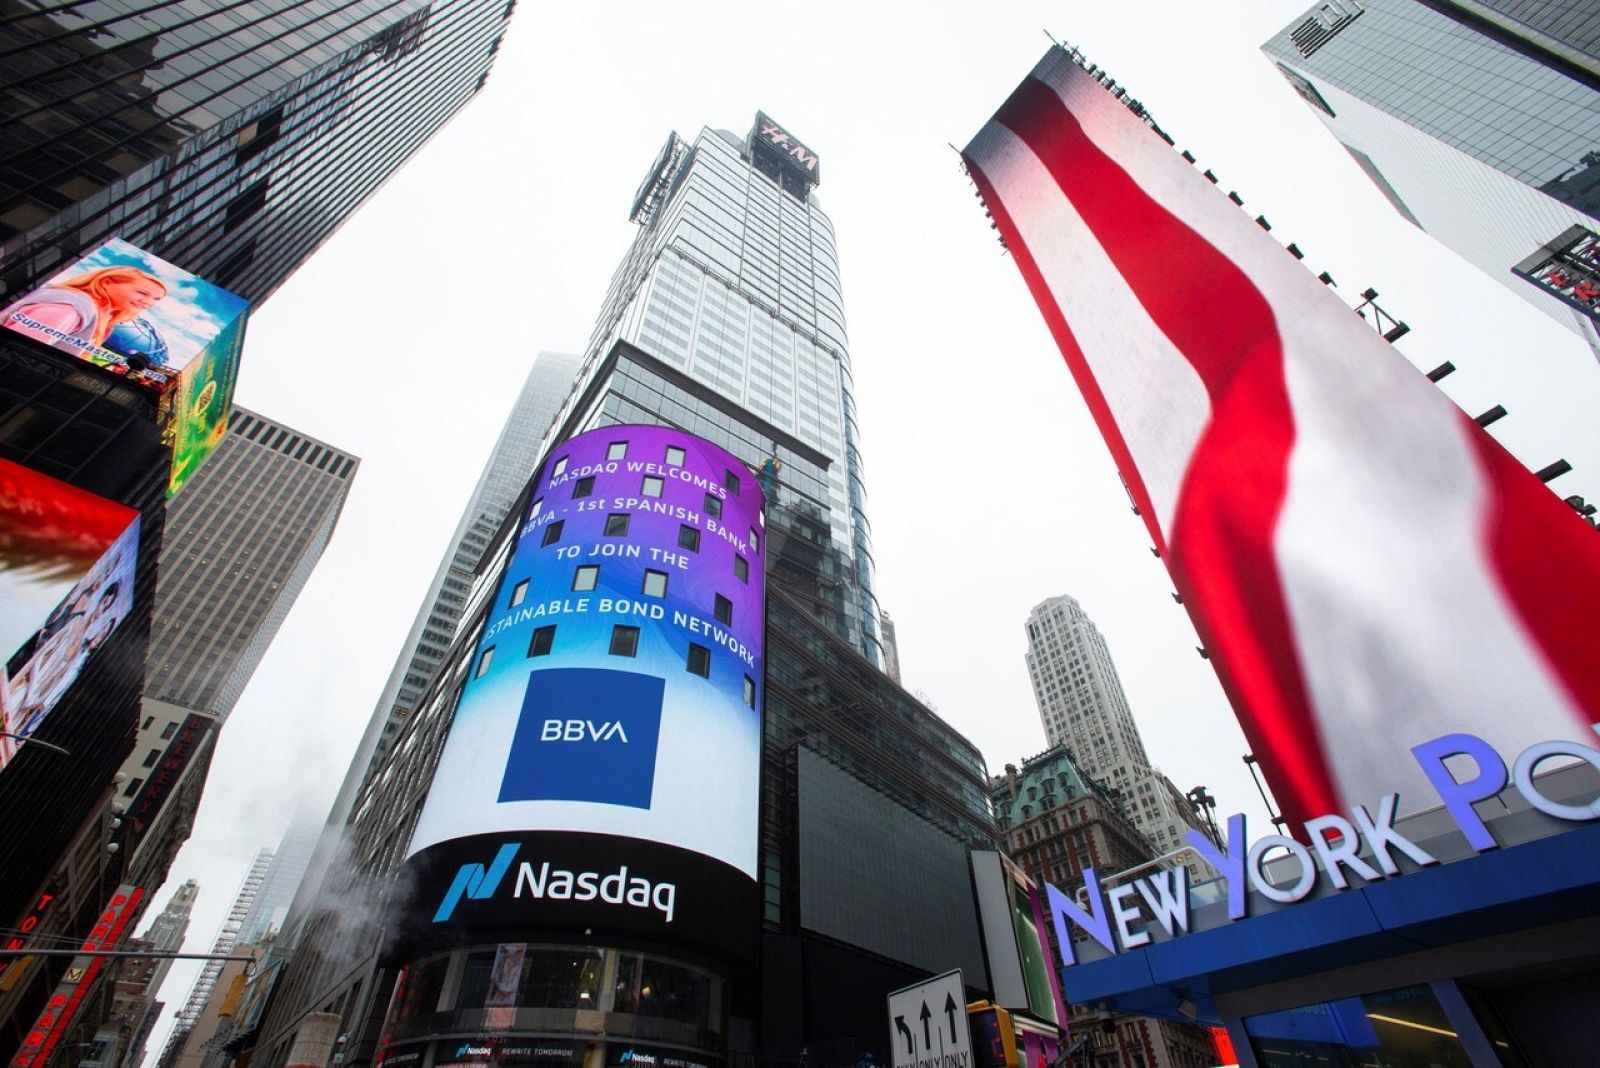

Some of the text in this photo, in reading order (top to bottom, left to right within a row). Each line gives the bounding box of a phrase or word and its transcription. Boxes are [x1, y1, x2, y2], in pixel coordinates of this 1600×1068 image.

[761, 124, 818, 172] H&M
[549, 461, 727, 499] NASDAQ WELCOMES
[577, 499, 605, 512] 1st
[613, 497, 700, 525] SPANISH
[707, 519, 747, 555] BANK
[556, 543, 690, 570] TO JOIN THE
[598, 598, 665, 620] BOND
[673, 610, 756, 669] NETWORK
[540, 719, 629, 744] BBVA
[1044, 721, 1600, 967] NEW YORK PO
[513, 862, 676, 923] Nasdaq
[944, 1051, 968, 1068] ONLY
